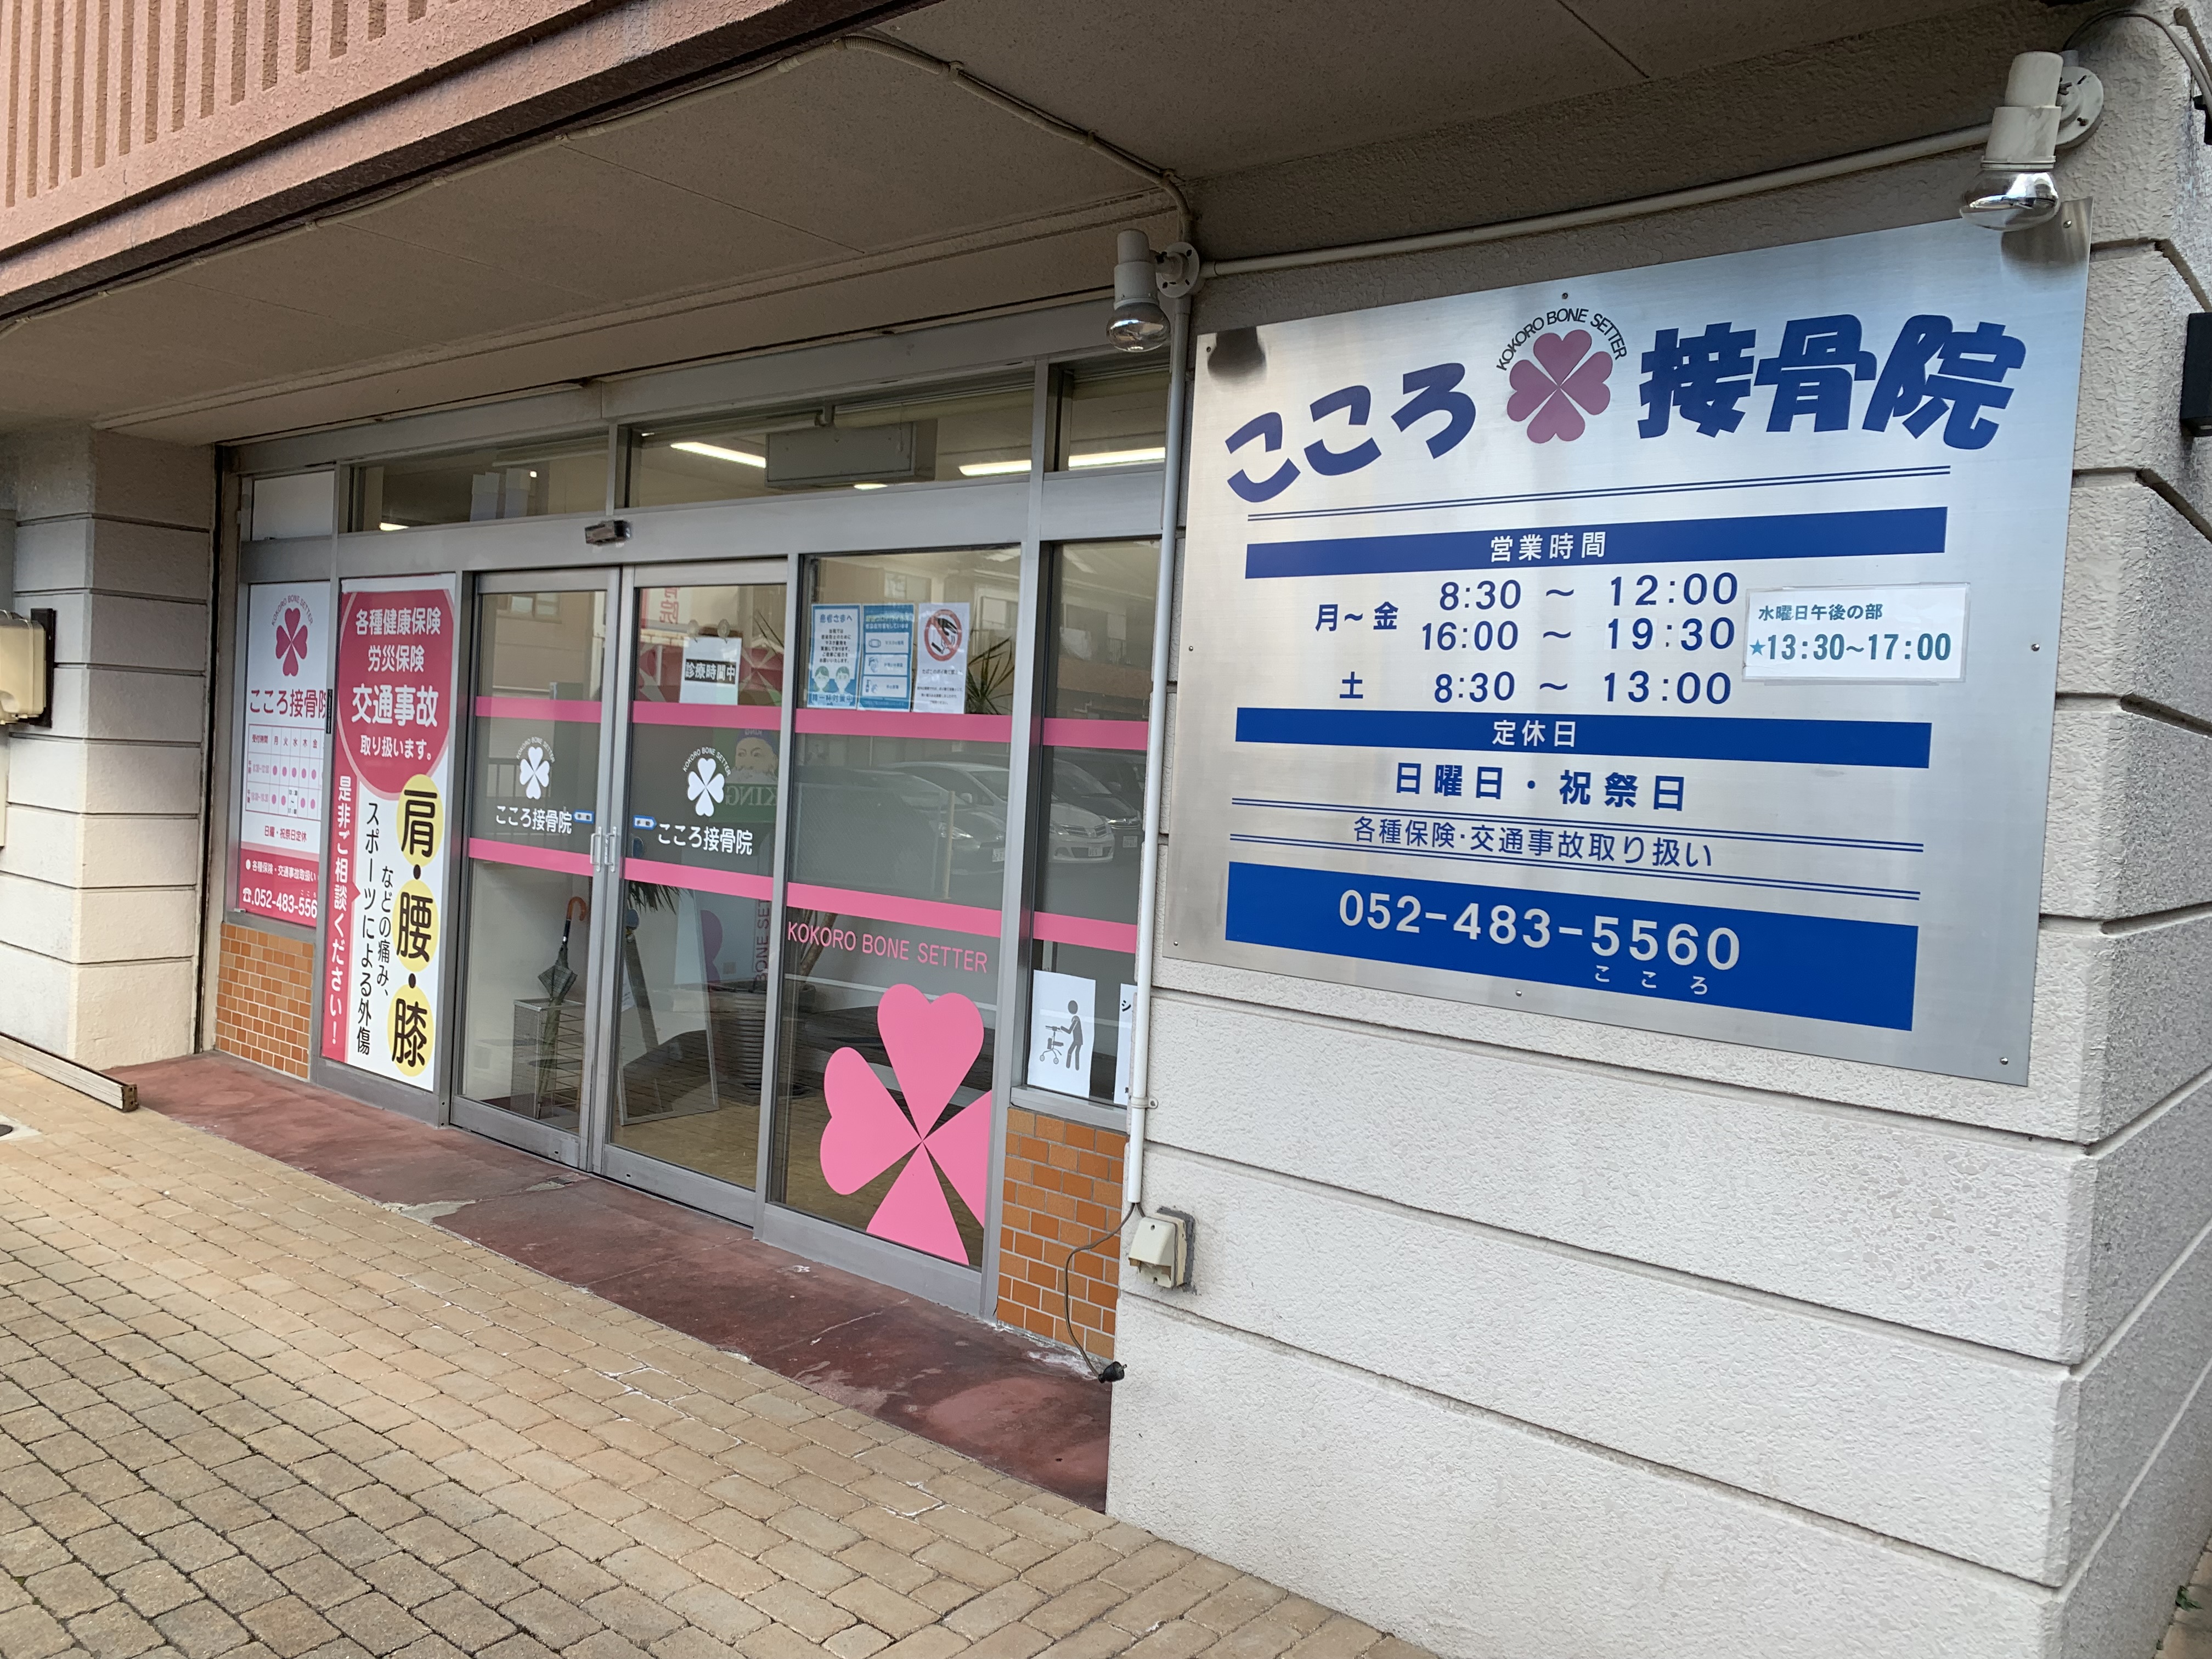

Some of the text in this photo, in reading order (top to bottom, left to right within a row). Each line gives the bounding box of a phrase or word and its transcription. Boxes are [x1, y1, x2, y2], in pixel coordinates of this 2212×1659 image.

[1496, 308, 1627, 371] KOKORO BONE SETTER
[1225, 314, 2026, 503] こころ 接骨院
[1491, 531, 1606, 562] 営業時間
[1440, 579, 1521, 611] 8:30
[1611, 572, 1738, 606] 12:00
[272, 594, 313, 626] KOKORO BONE SETTER
[355, 606, 442, 636] 各種健康保険
[1758, 603, 1883, 621] 水曜日午後の部
[1423, 620, 1519, 651] 16:00
[1608, 617, 1735, 651] 19:30
[368, 644, 426, 673] 労災保険
[685, 660, 736, 682] 診療時間中
[1339, 671, 1363, 699] 土
[1434, 671, 1515, 703] 8:30
[1604, 670, 1731, 704] 13:00
[351, 683, 439, 727] 交通事故
[274, 736, 278, 745] 月
[283, 737, 289, 747] 火
[293, 738, 298, 747] 水
[303, 739, 308, 747] 木
[313, 739, 318, 749] 金
[360, 734, 432, 760] 取り扱います。
[1492, 719, 1577, 748] 定休日
[682, 747, 731, 776] KOKORO BONE SETTER
[495, 805, 572, 834] こころ接骨院
[658, 822, 754, 856] こころ接骨院
[1353, 815, 1713, 868] 各種保険・交通事故取り扱い
[357, 802, 380, 1056] スポーツによる外傷
[1339, 889, 1741, 970] 052-483-5560
[787, 921, 988, 974] KOKORO BONE SETTER
